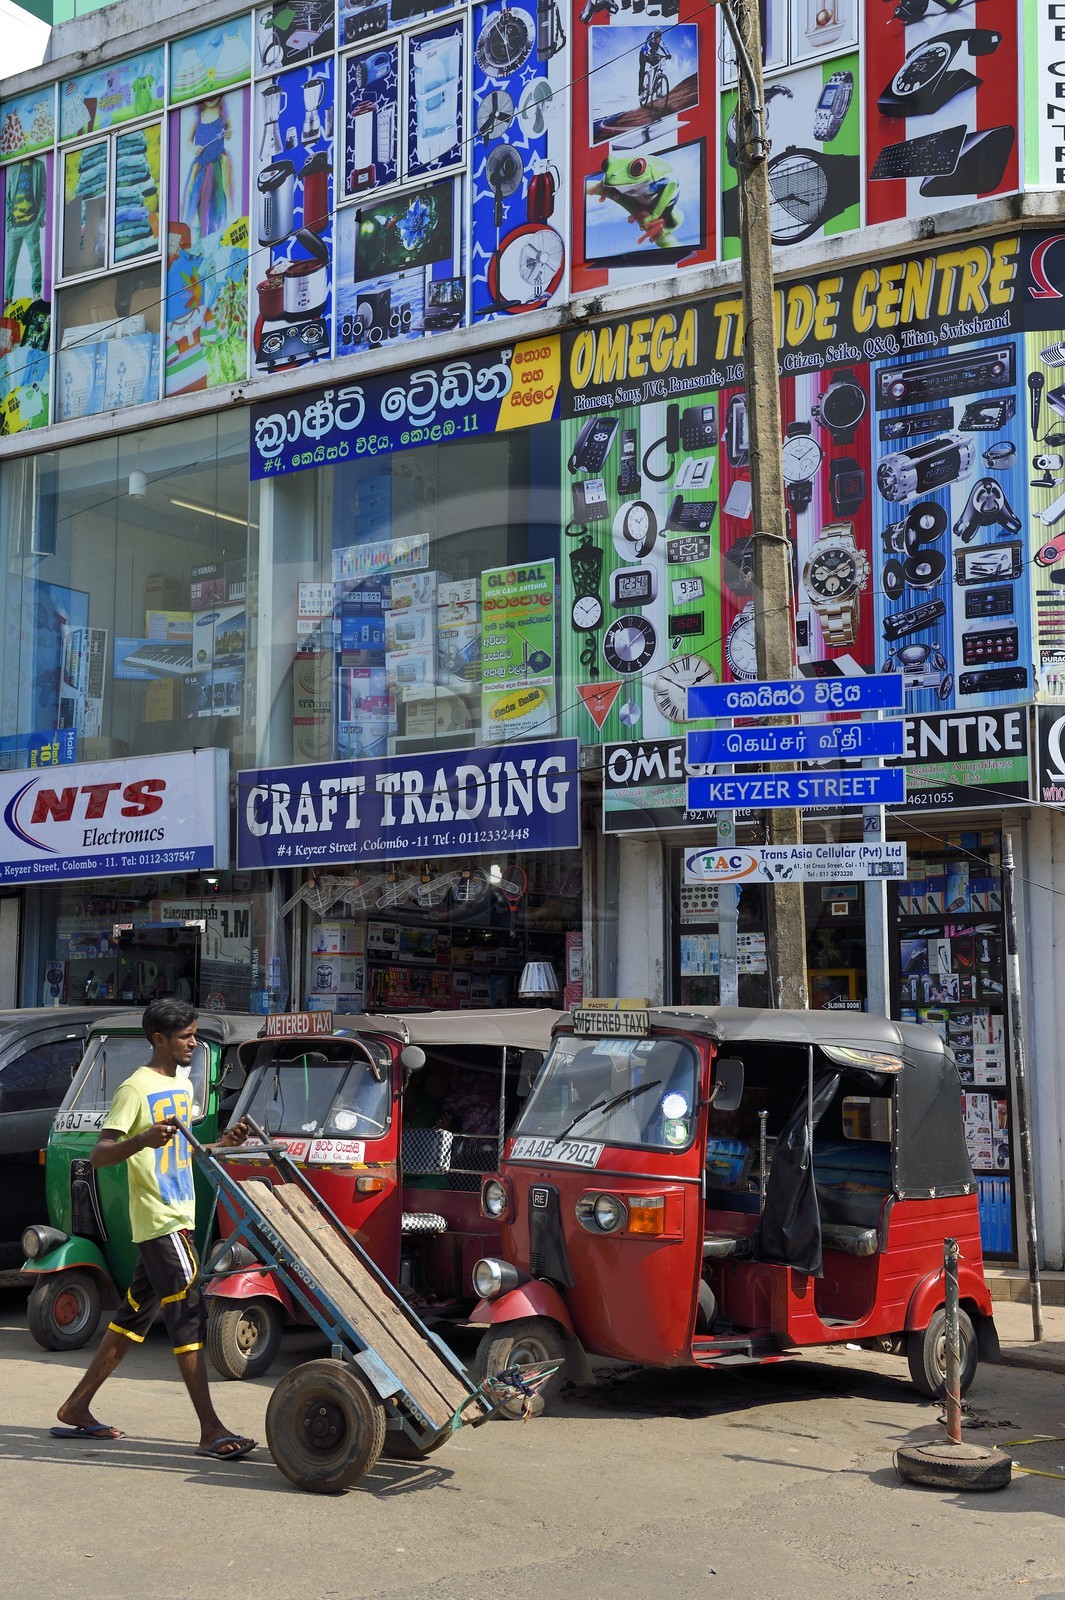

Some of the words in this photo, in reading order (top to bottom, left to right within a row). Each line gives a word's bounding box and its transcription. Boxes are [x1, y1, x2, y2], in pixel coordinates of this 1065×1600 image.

[569, 308, 698, 390] OMEGA
[713, 276, 844, 362] TDE
[852, 237, 1020, 334] CENTRE
[514, 346, 551, 364] තොග
[573, 393, 614, 412] Pioneer,
[614, 387, 641, 405] Sony,
[642, 380, 668, 401] JVC,
[668, 369, 725, 393] Panasonic,
[784, 353, 824, 372] Ctizen,
[826, 344, 861, 363] Seiko,
[863, 334, 899, 356] Q&Q,
[901, 328, 938, 348] Titan,
[940, 310, 1011, 341] Swissbrand
[520, 368, 544, 385] සහ
[510, 385, 554, 407] සිල්ලර
[485, 589, 500, 598] HIGH
[502, 586, 518, 594] GAIN
[519, 582, 548, 592] ANTENNA
[488, 568, 546, 588] GLOBAL
[726, 684, 805, 709] කෙයිසර්
[814, 682, 861, 707] වීදිය
[66, 732, 75, 760] Haier
[608, 745, 718, 783] OME
[886, 711, 1022, 760] ENTRE
[726, 730, 807, 753] கெய்சர்
[819, 726, 862, 752] வீதி
[614, 788, 647, 799] Whole
[910, 765, 948, 776] Radio,
[952, 759, 1013, 772] Amplifiers
[710, 780, 792, 802] KEYZER
[798, 776, 880, 799] STREET
[30, 779, 167, 824] NTS
[245, 776, 366, 837] CRAFT
[375, 755, 570, 826] TRADING
[690, 811, 704, 821] 92,
[908, 792, 954, 805] 4621055
[82, 826, 165, 848] Electronics
[277, 844, 292, 857] #4
[294, 844, 328, 860] Keyzer
[328, 841, 358, 854] Street
[458, 828, 530, 845] 0112332448
[4, 865, 32, 877] Keyzer
[33, 862, 60, 874] Street,
[62, 859, 97, 870] Colombo
[105, 858, 118, 867] 11.
[121, 856, 137, 866] Tel:
[139, 851, 196, 865] 0112-337547
[702, 856, 742, 870] TAC
[760, 849, 788, 860] Trans
[790, 848, 813, 859] Asia
[816, 846, 856, 858] Cellular
[858, 846, 882, 860] (Pvt)
[886, 846, 902, 858] Ltd
[828, 862, 844, 870] Street,
[828, 1002, 846, 1010] SLIDING
[846, 1002, 860, 1010] DOOR
[266, 1014, 310, 1036] METERED
[312, 1012, 332, 1032] TAXI
[577, 1012, 621, 1033] METERED
[624, 1013, 646, 1034] TAXI
[524, 1140, 556, 1158] AAB
[557, 1142, 598, 1164] 7901
[534, 1195, 544, 1204] RE
